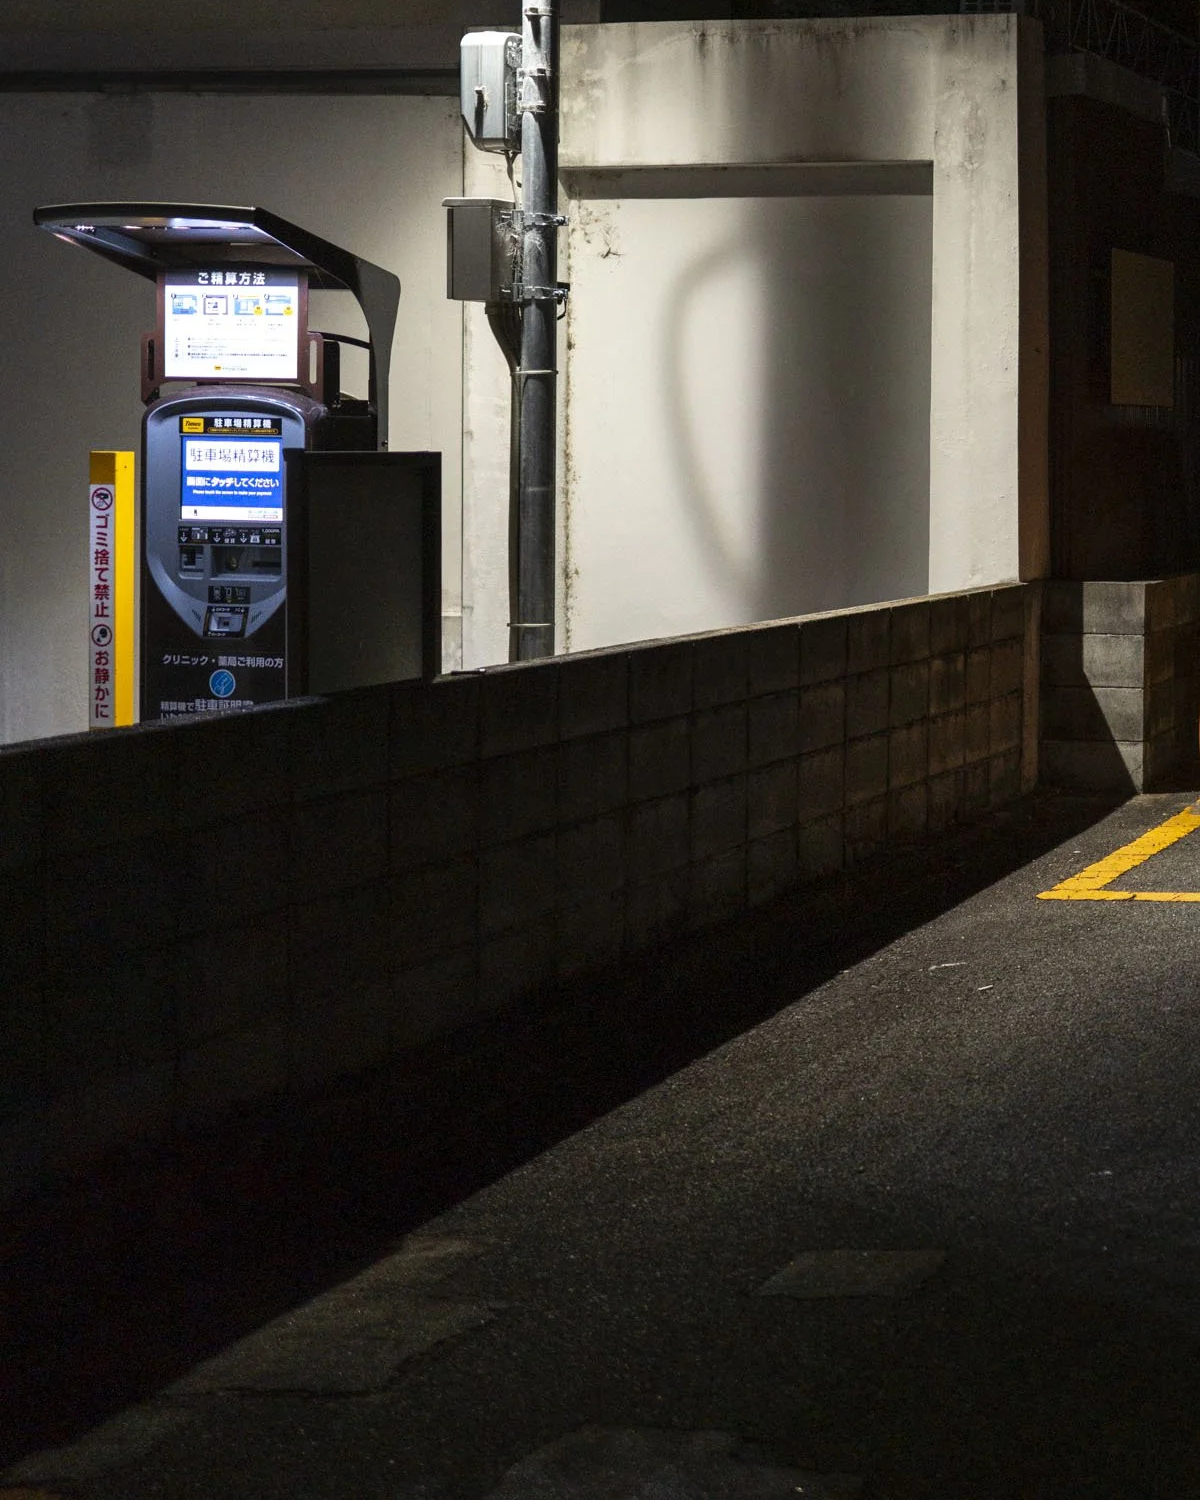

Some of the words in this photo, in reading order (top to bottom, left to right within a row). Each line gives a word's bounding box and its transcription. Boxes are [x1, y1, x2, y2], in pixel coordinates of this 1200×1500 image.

[198, 272, 266, 285] ご精算方法
[214, 418, 272, 429] 駐車場精算機
[190, 448, 275, 463] 駐車場精算機
[186, 476, 279, 487] 画面にタッチしてください
[94, 513, 110, 618] ゴミ捨て禁止
[162, 654, 284, 668] クリニック・薬局ご利用の方
[94, 651, 110, 719] お静かに
